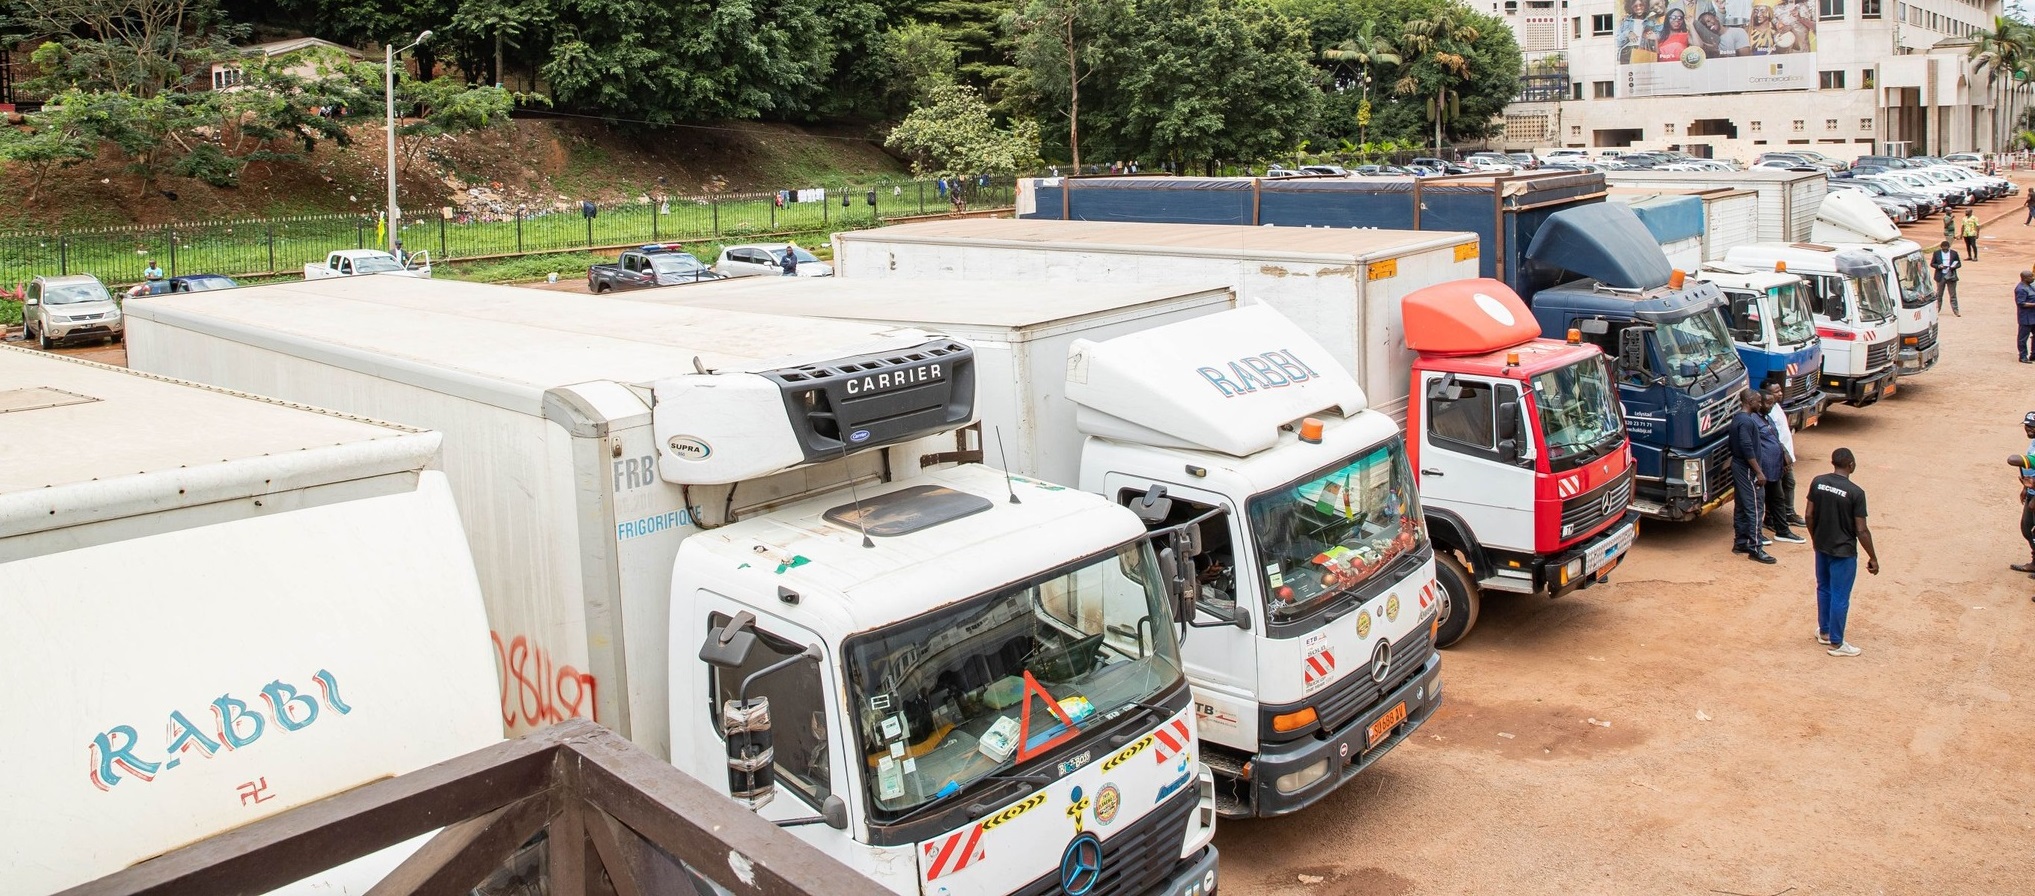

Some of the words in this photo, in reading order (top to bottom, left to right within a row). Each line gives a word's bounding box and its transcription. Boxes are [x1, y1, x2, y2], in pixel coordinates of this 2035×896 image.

[846, 363, 943, 395] CARRIER
[1196, 349, 1320, 398] RABBI
[670, 442, 701, 453] SUPRA
[613, 455, 654, 493] FRB
[1817, 483, 1847, 498] SECURITE
[1306, 636, 1318, 645] ETB
[90, 669, 352, 792] RABBI
[1074, 750, 1091, 768] BOSS
